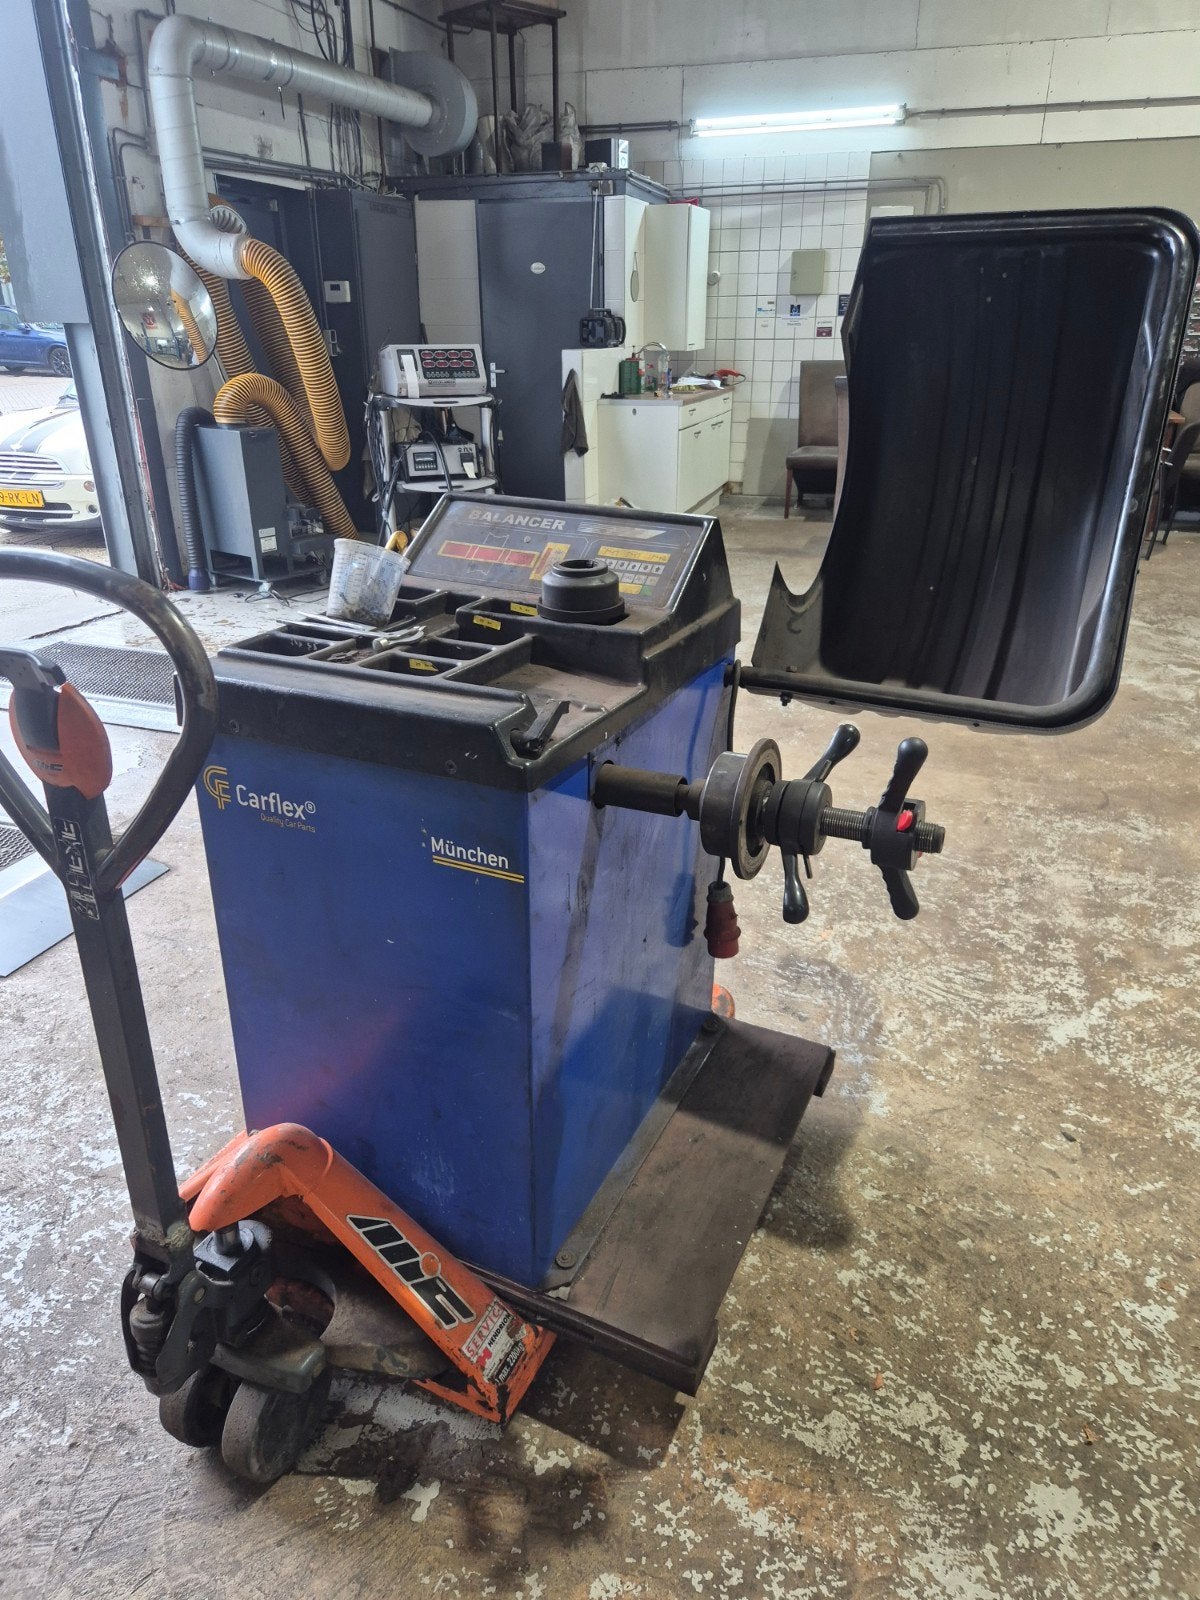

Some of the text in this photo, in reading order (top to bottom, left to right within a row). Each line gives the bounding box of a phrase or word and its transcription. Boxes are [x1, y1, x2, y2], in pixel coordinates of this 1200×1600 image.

[468, 509, 566, 532] BALANCER
[261, 813, 316, 833] Quality Car Parts
[431, 836, 509, 869] München
